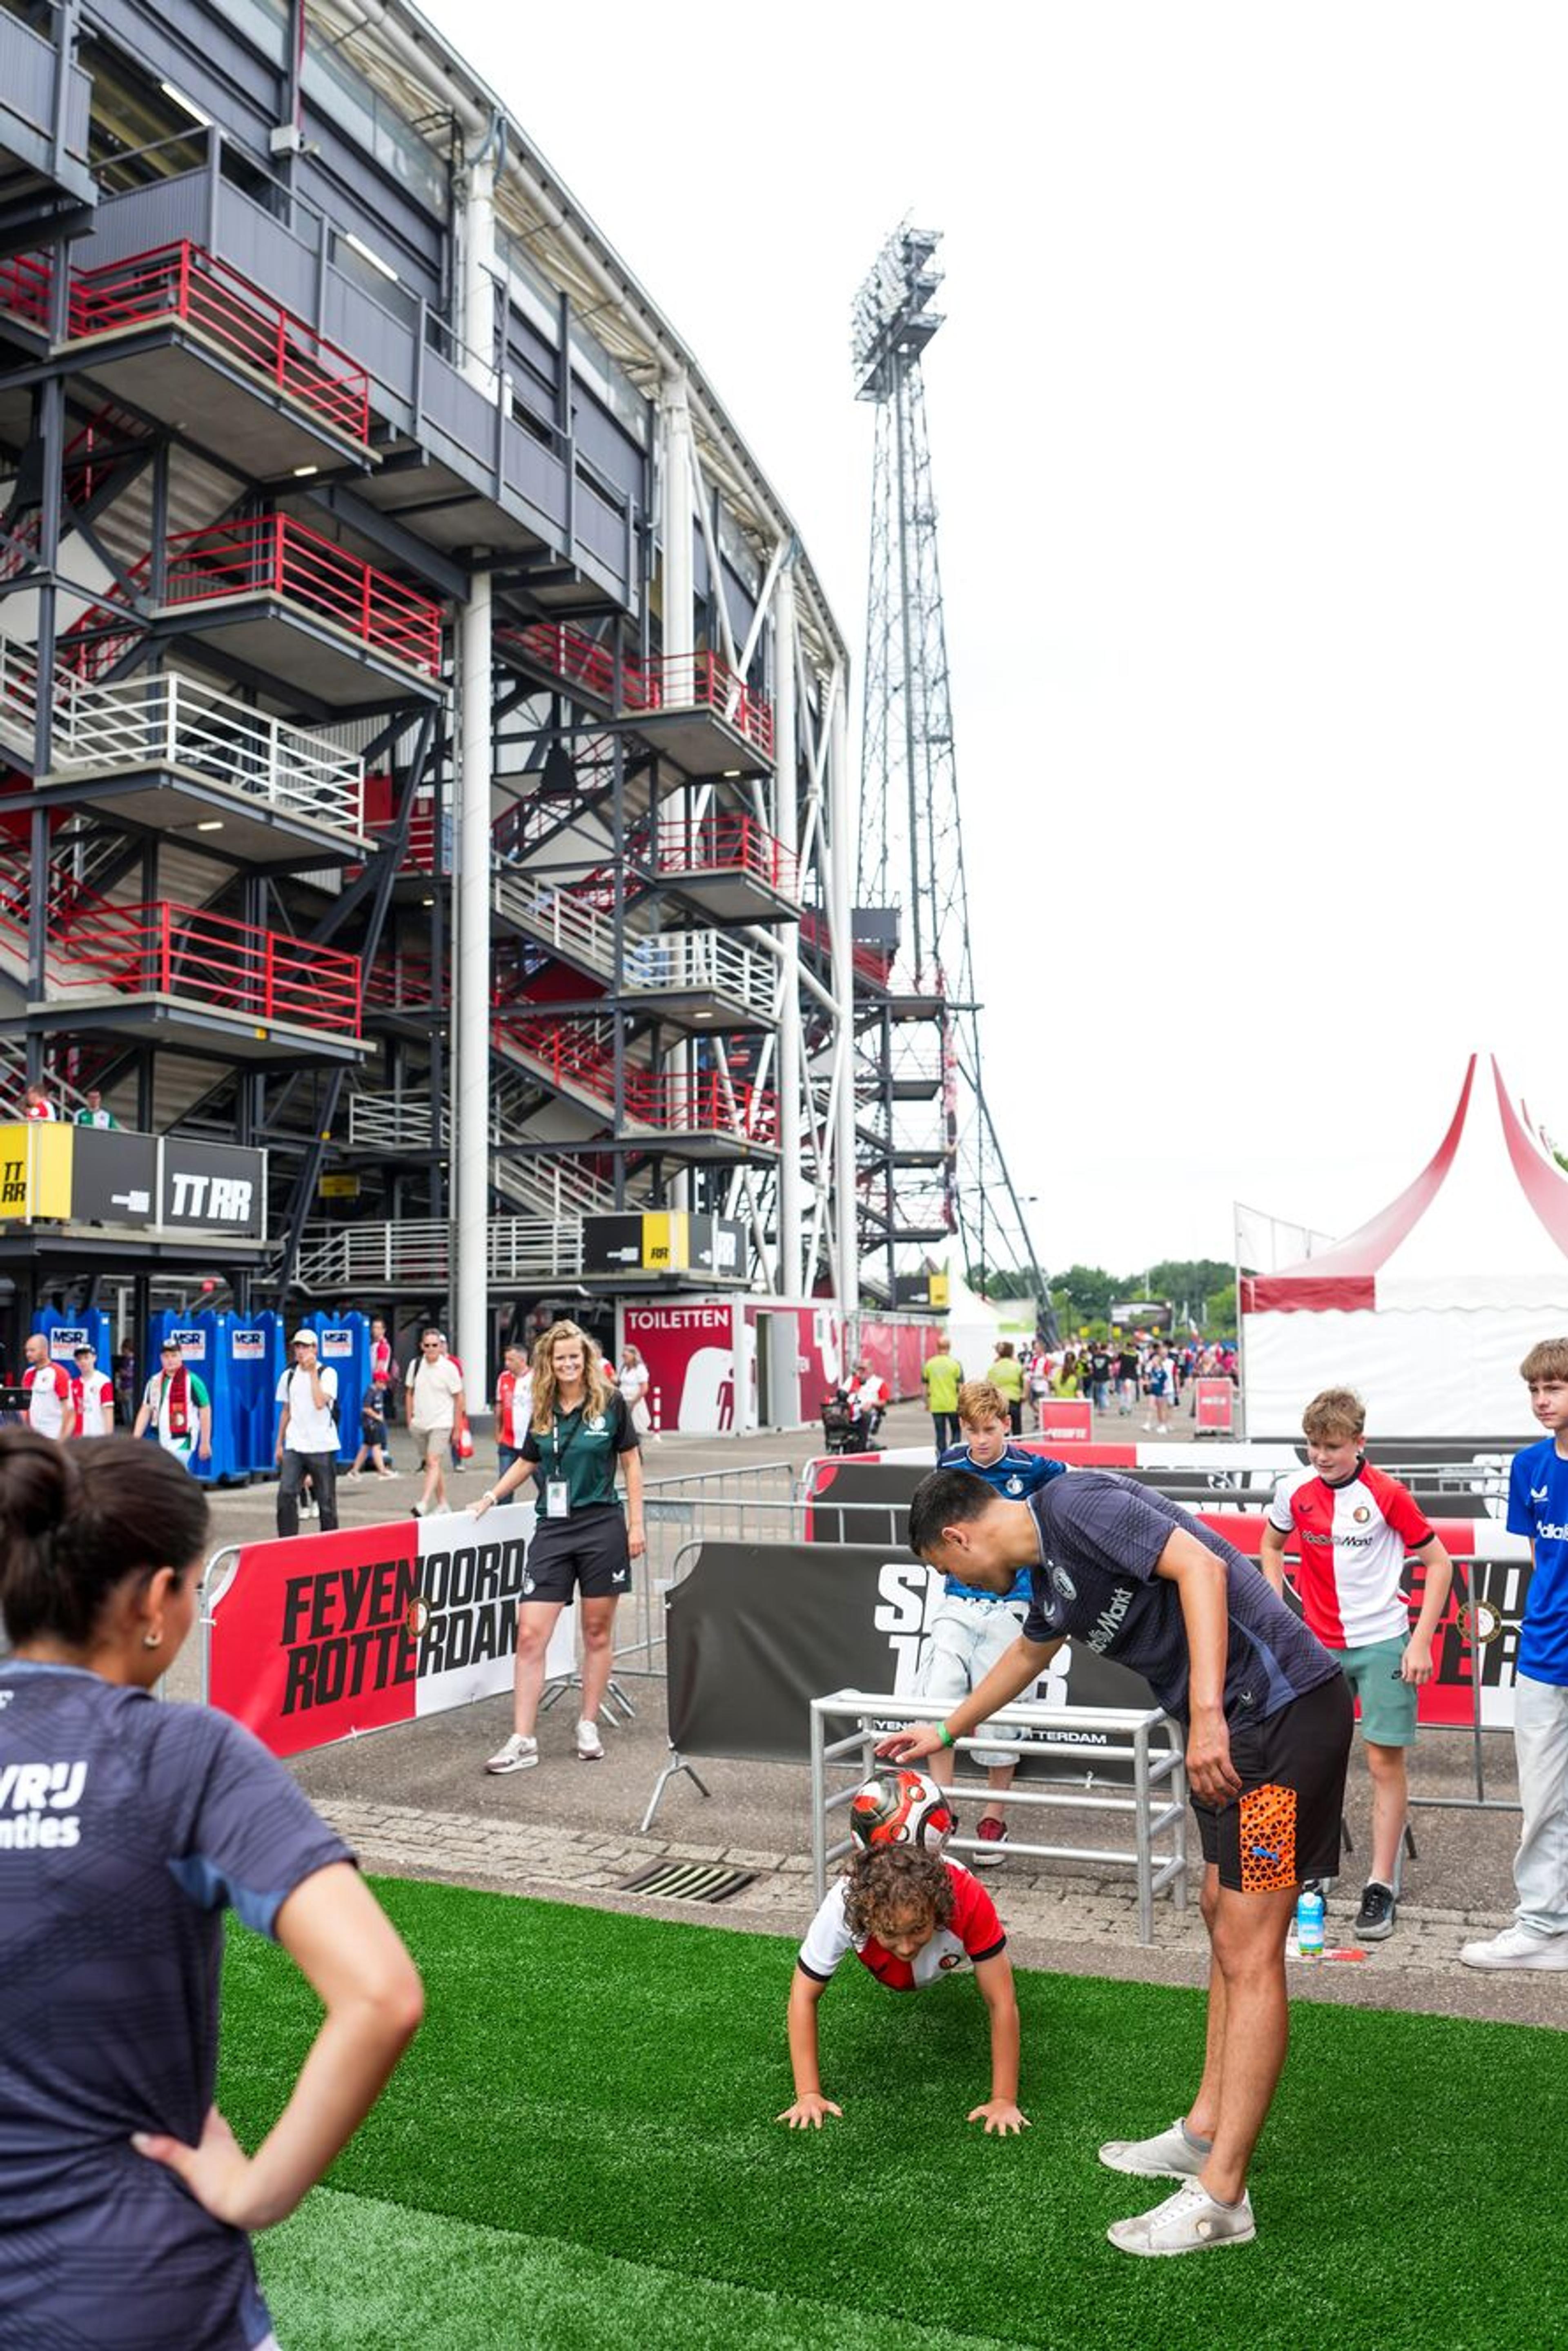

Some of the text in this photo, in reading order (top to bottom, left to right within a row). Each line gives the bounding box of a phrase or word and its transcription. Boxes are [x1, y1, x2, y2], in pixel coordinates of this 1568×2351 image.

[5, 1161, 24, 1181] TT
[2, 1182, 26, 1202] RR
[628, 1309, 729, 1330] TOILETTEN
[53, 1331, 84, 1343] MSR
[280, 1538, 525, 1645] FEYENOORD
